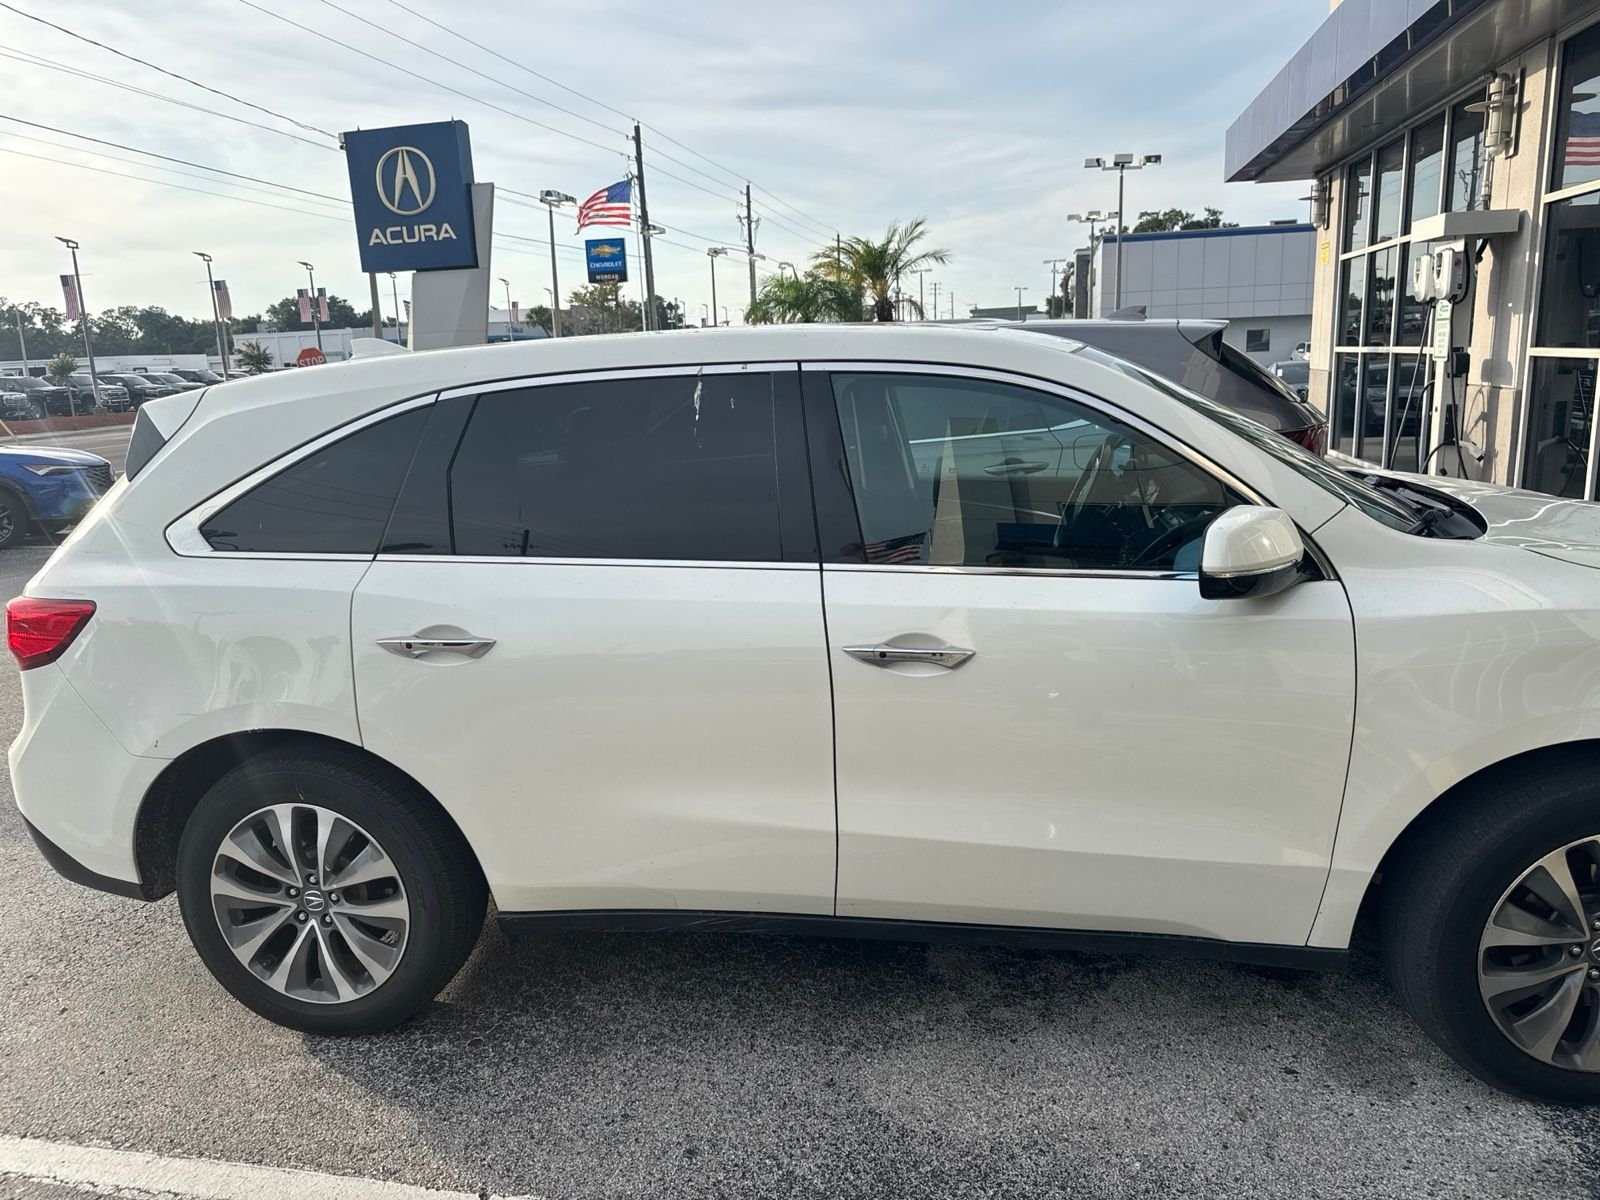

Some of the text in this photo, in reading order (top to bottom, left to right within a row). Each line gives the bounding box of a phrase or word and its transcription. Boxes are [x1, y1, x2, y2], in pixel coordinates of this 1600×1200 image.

[369, 222, 457, 246] ACURA
[590, 261, 622, 269] CHEVROLET
[299, 355, 325, 367] STOP
